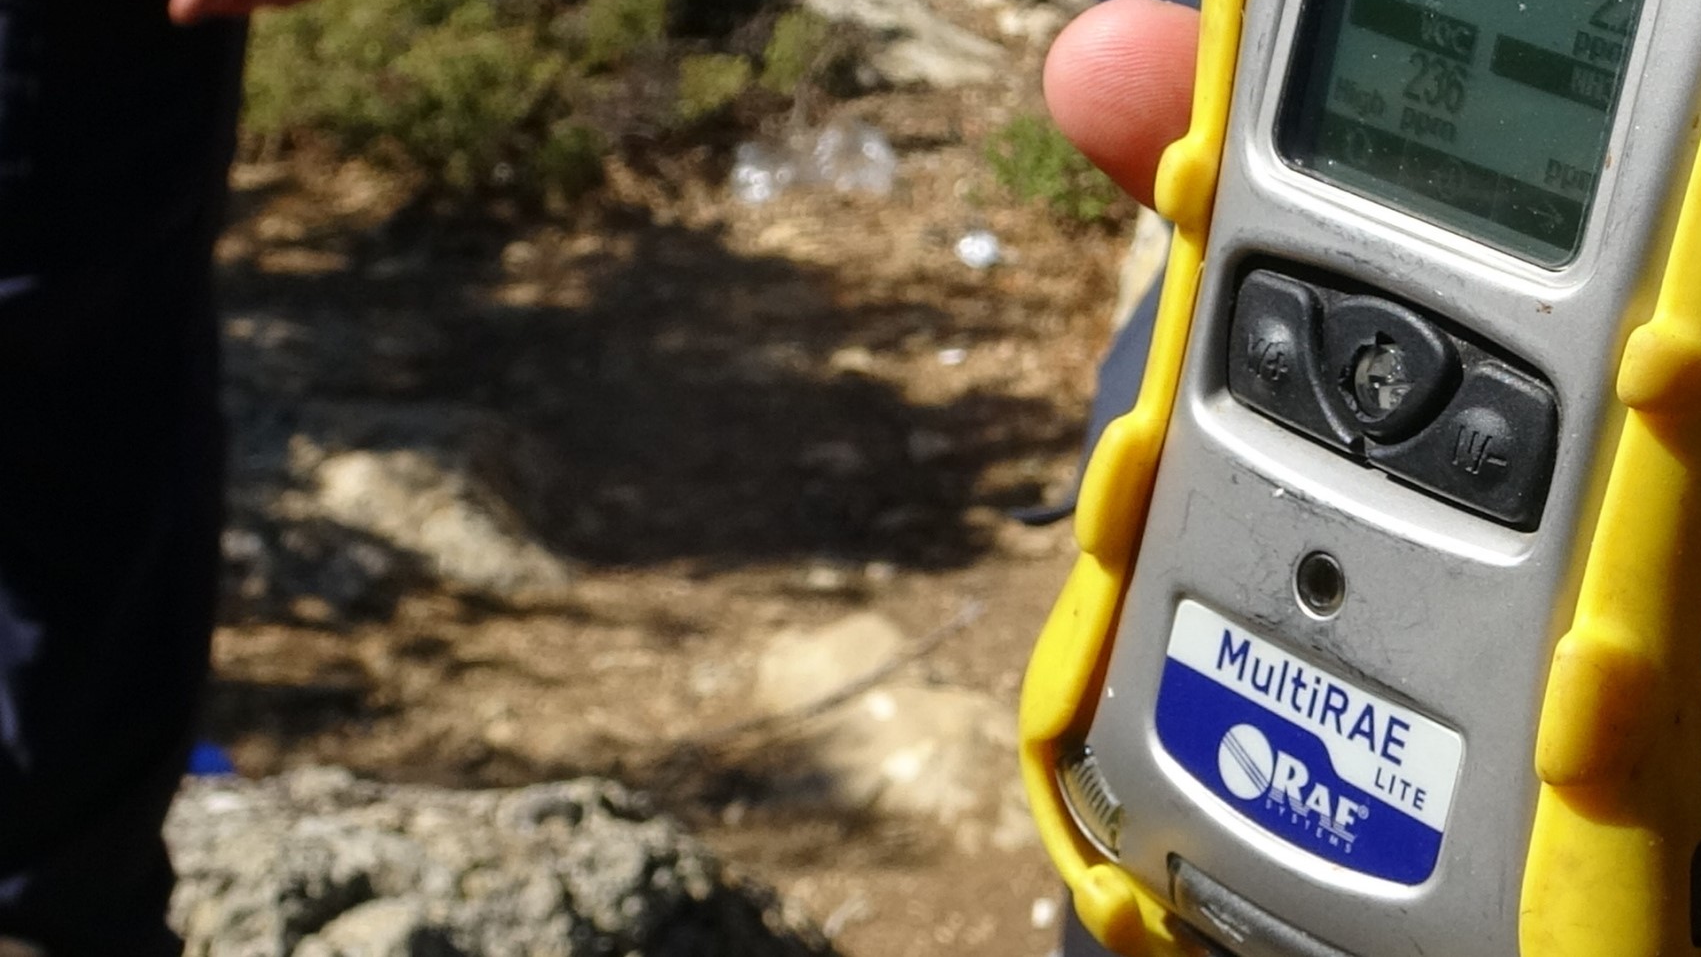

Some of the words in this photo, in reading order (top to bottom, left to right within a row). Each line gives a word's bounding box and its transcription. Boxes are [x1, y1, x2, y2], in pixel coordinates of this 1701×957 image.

[1216, 629, 1410, 766] MultiRAE
[1374, 766, 1428, 812] LITE
[1265, 798, 1353, 853] SYSTEMS
